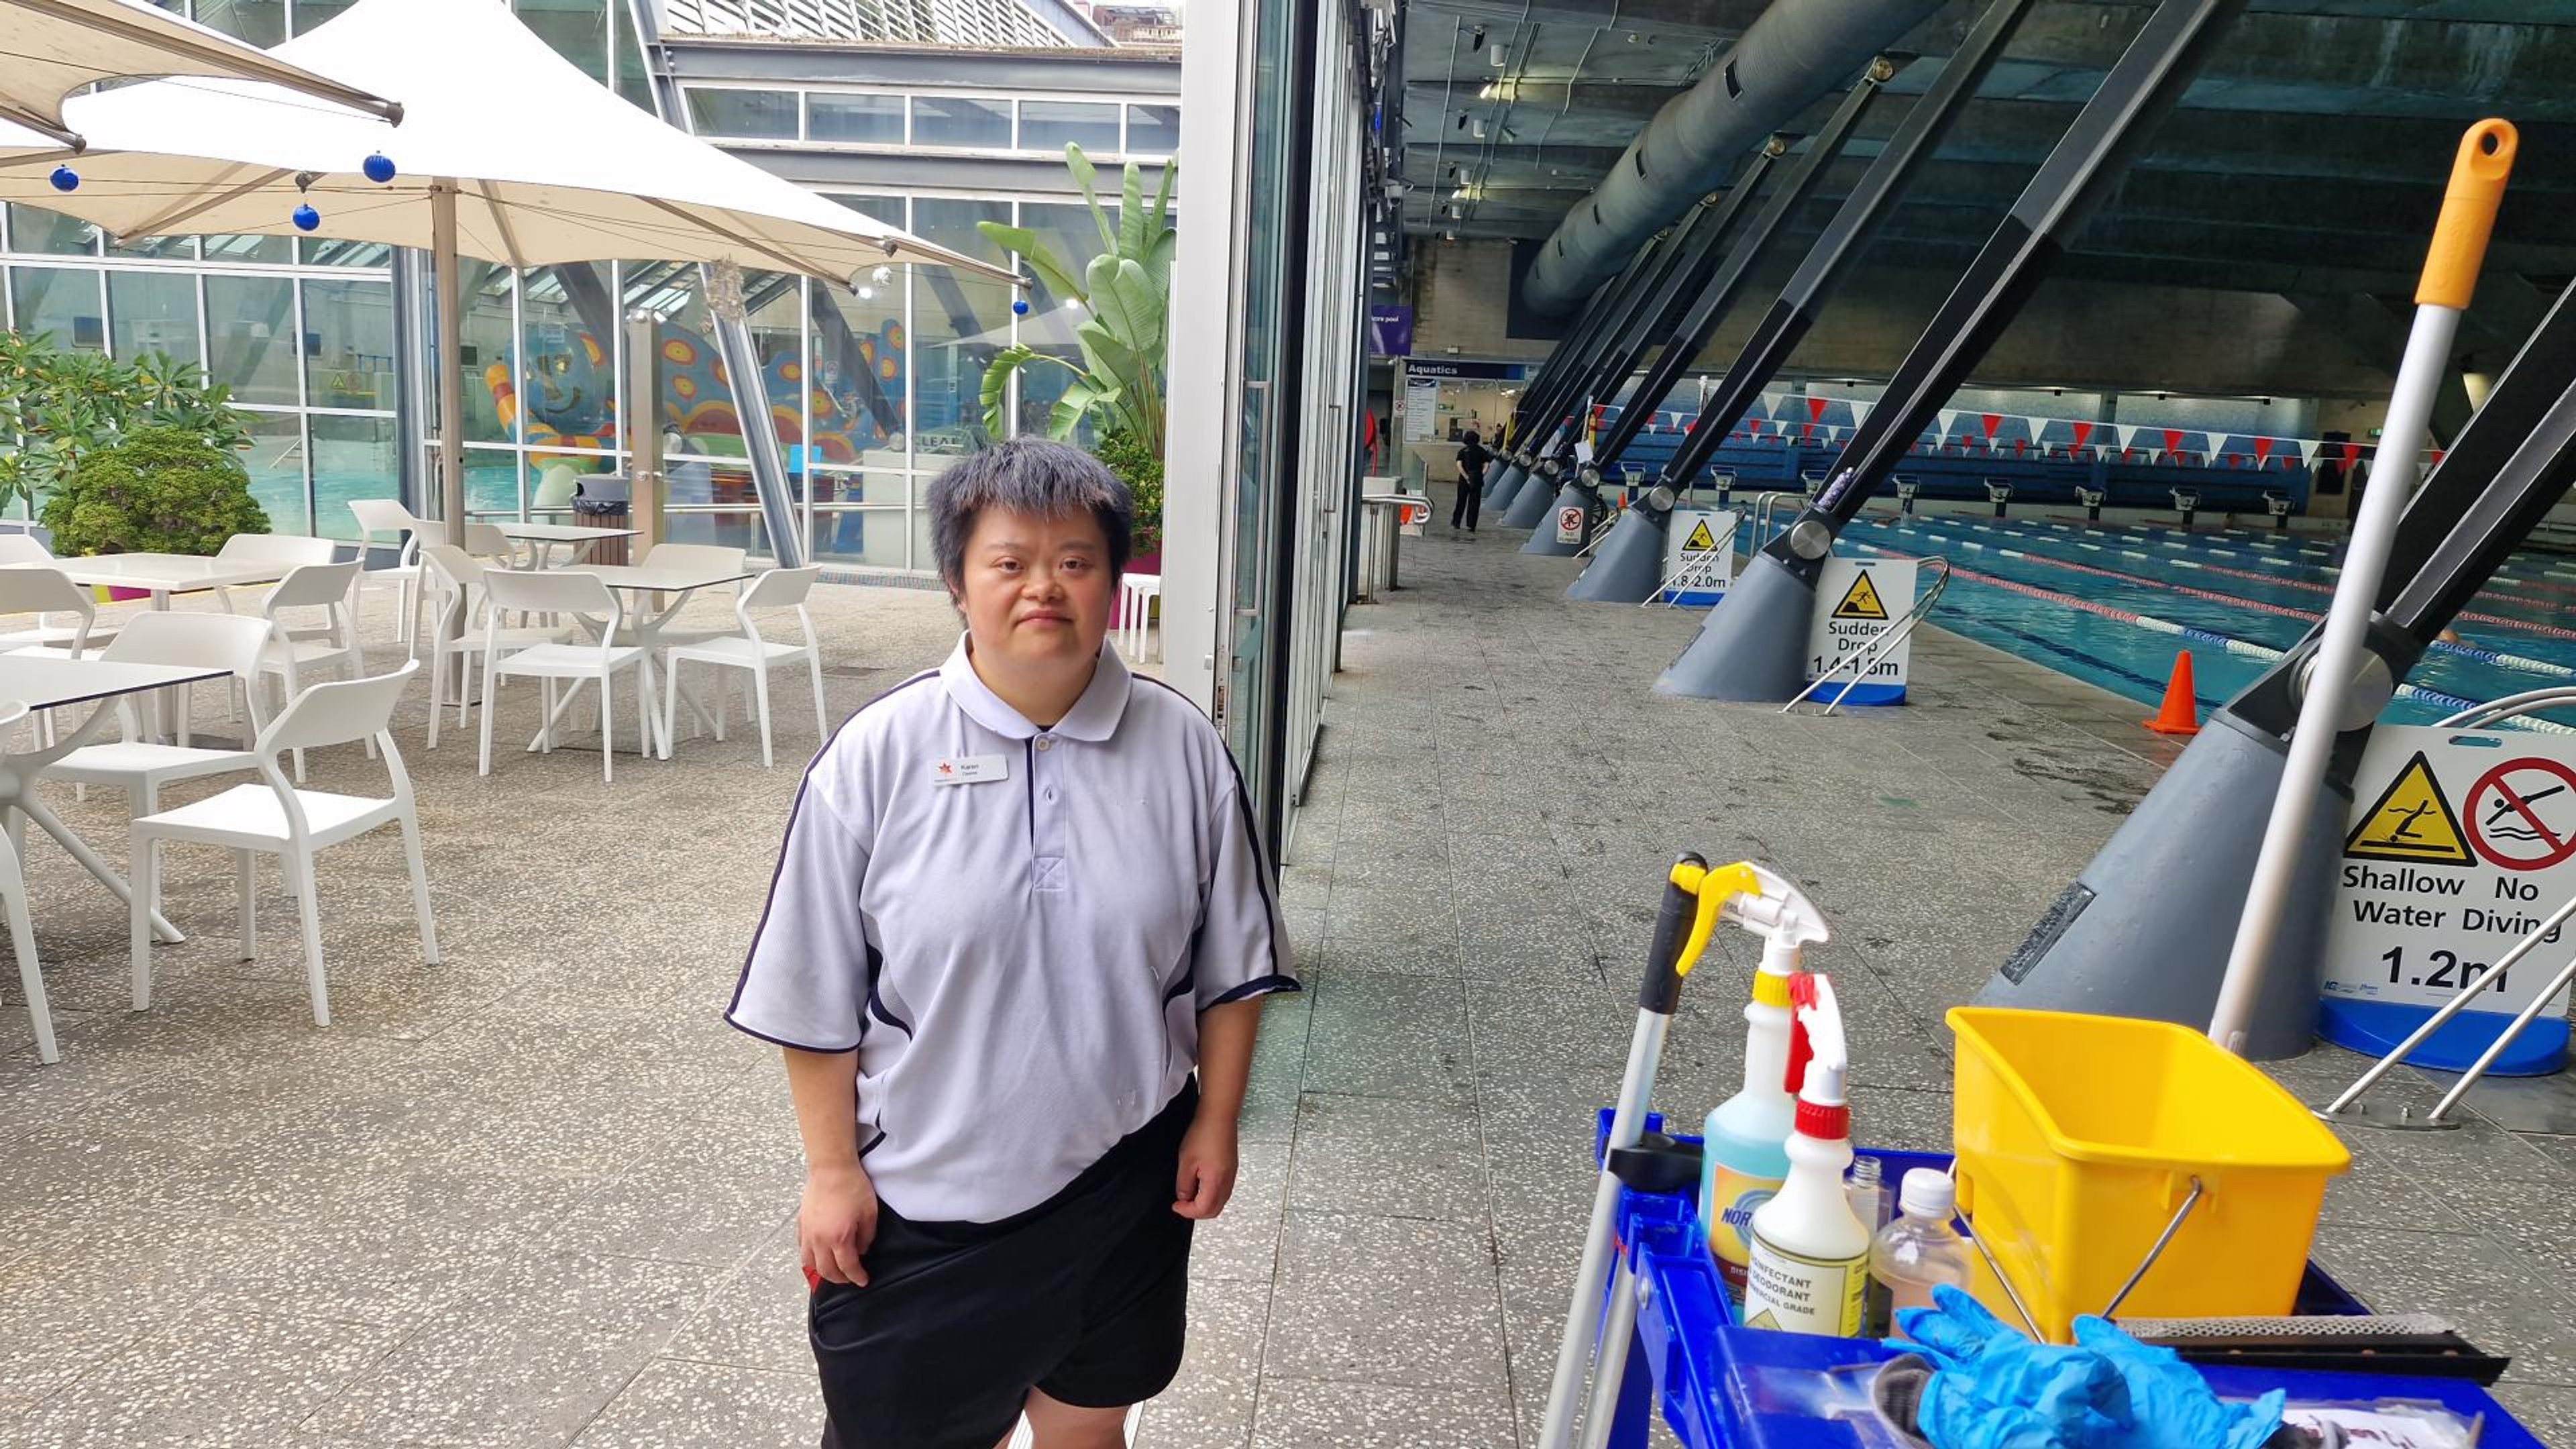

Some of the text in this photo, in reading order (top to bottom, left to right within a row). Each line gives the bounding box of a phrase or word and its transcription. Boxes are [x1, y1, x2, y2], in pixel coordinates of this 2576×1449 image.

[1409, 364, 1458, 375] Aquatics
[1829, 621, 1889, 636] Sudden
[1814, 655, 1898, 676] 1.4-18m
[2343, 865, 2465, 896] Shallow
[2495, 876, 2539, 901] No
[2353, 900, 2446, 928] Water
[2462, 908, 2562, 943] Diving
[2382, 946, 2508, 992] 1.2m
[1752, 1269, 1811, 1302] DEODORANT
[1783, 1301, 1815, 1315] GRADE
